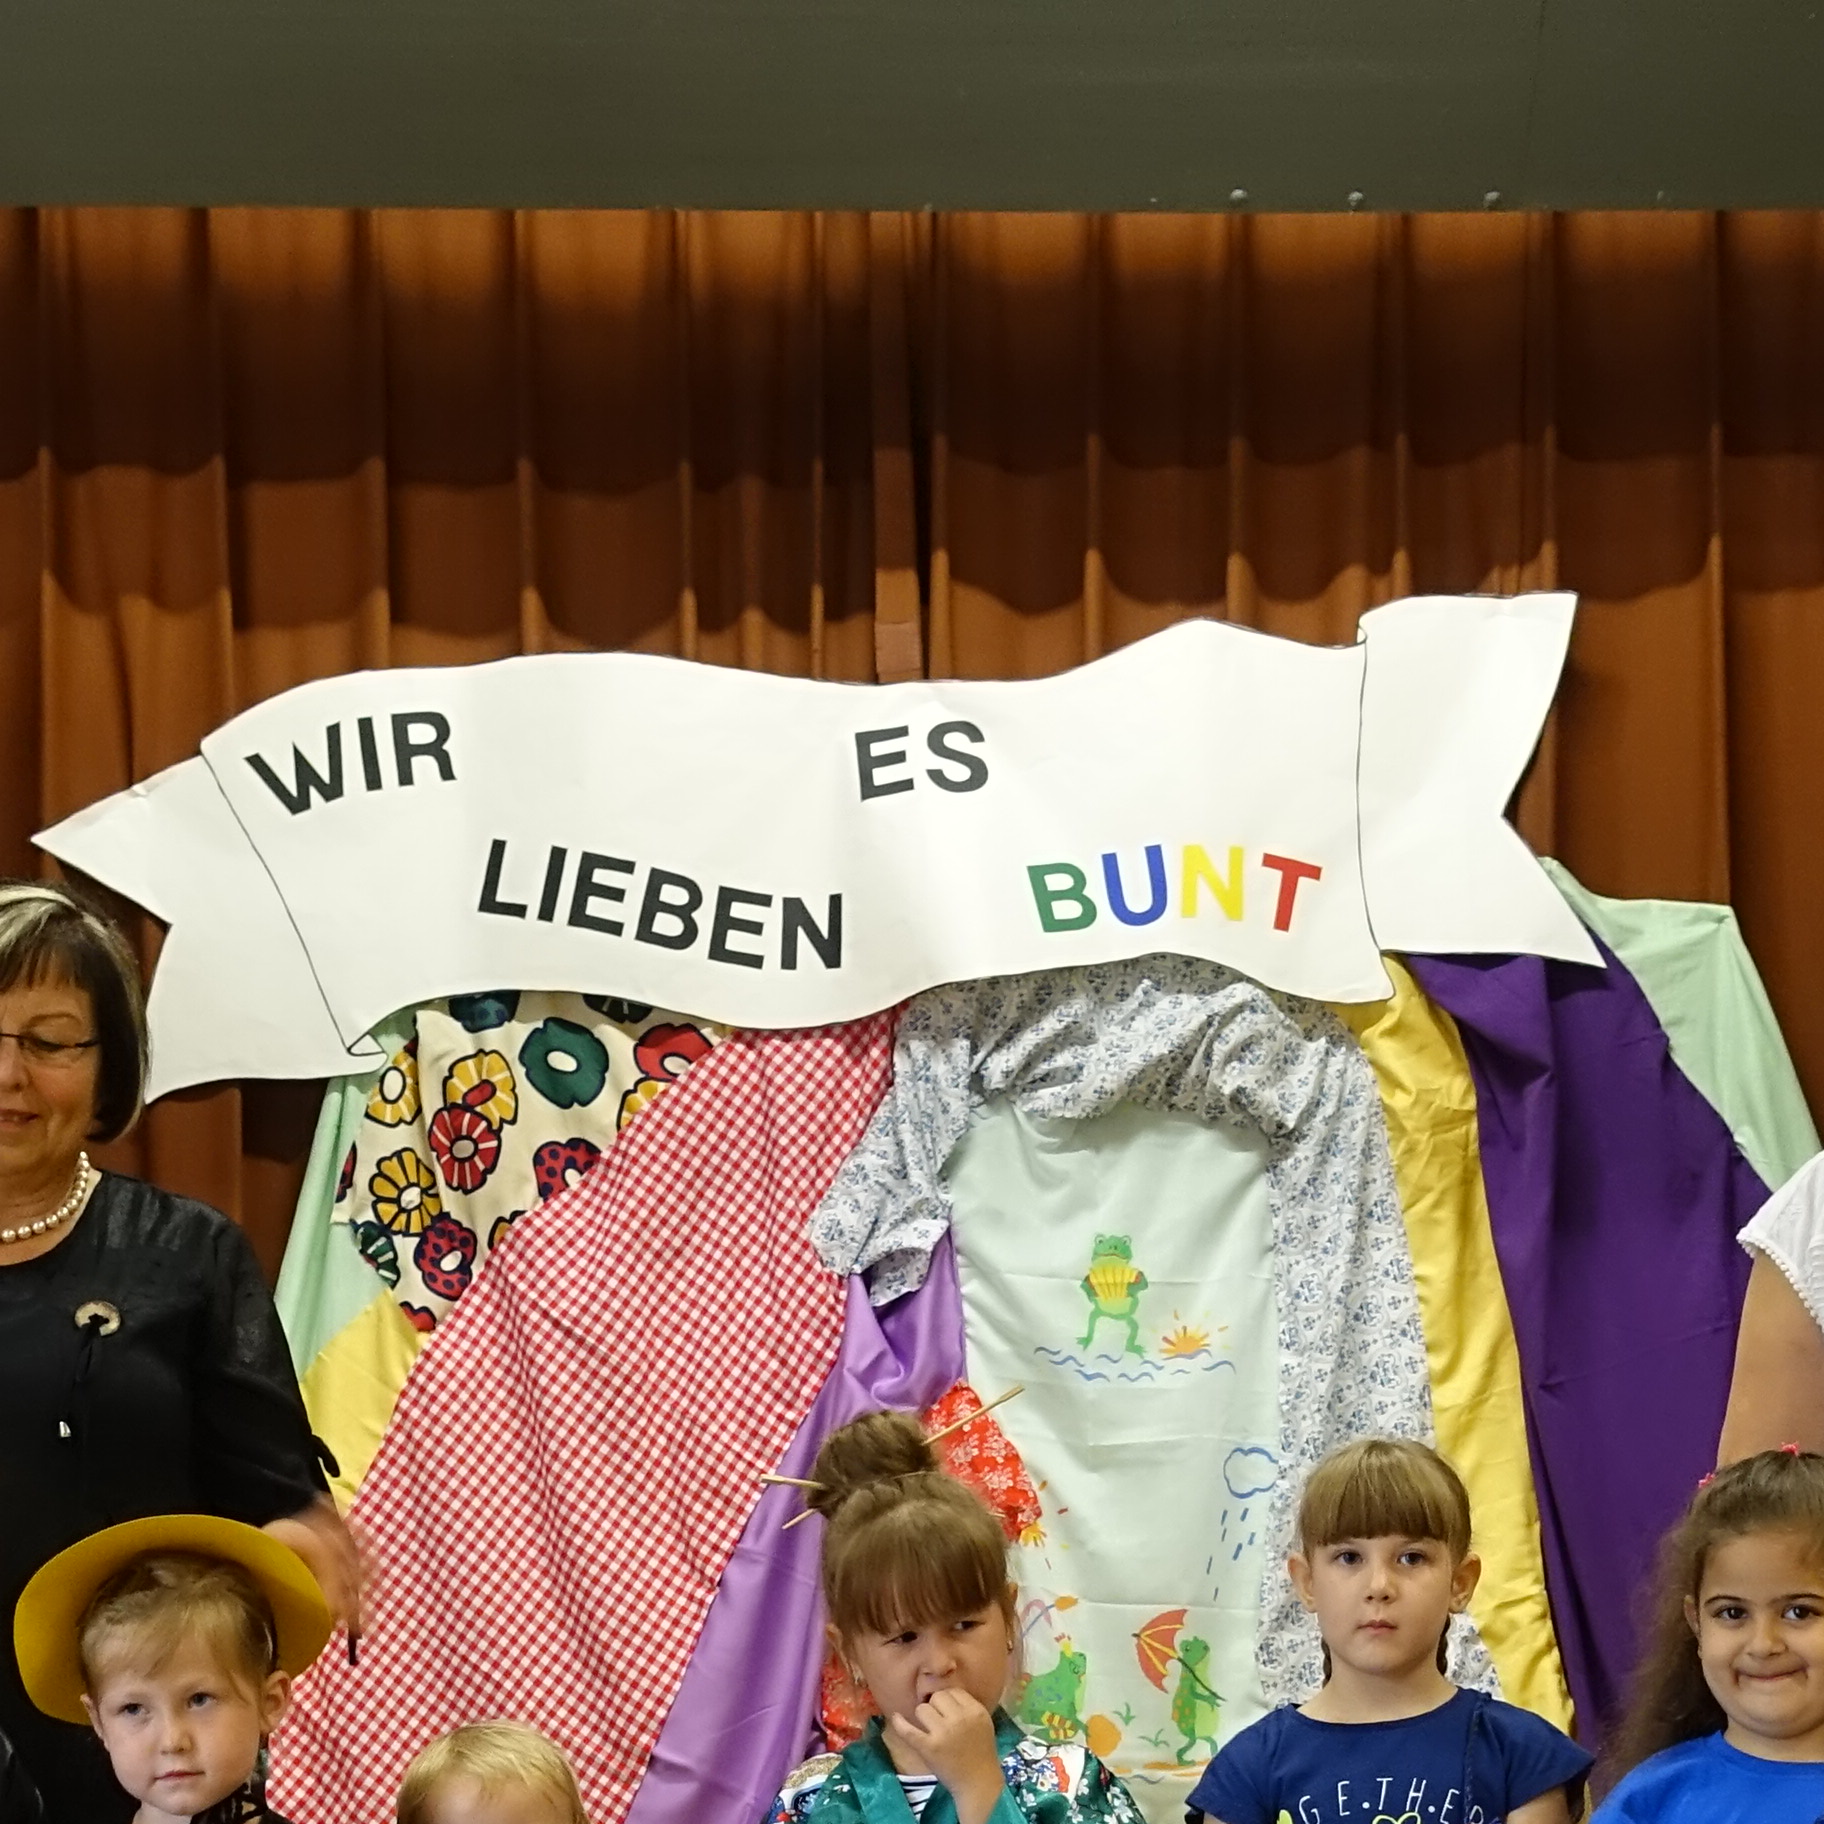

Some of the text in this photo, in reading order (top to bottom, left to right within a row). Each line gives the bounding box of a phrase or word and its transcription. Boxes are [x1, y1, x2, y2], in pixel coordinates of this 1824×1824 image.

[244, 710, 989, 815] WIR ES
[477, 839, 1323, 970] LIEBEN BUNT
